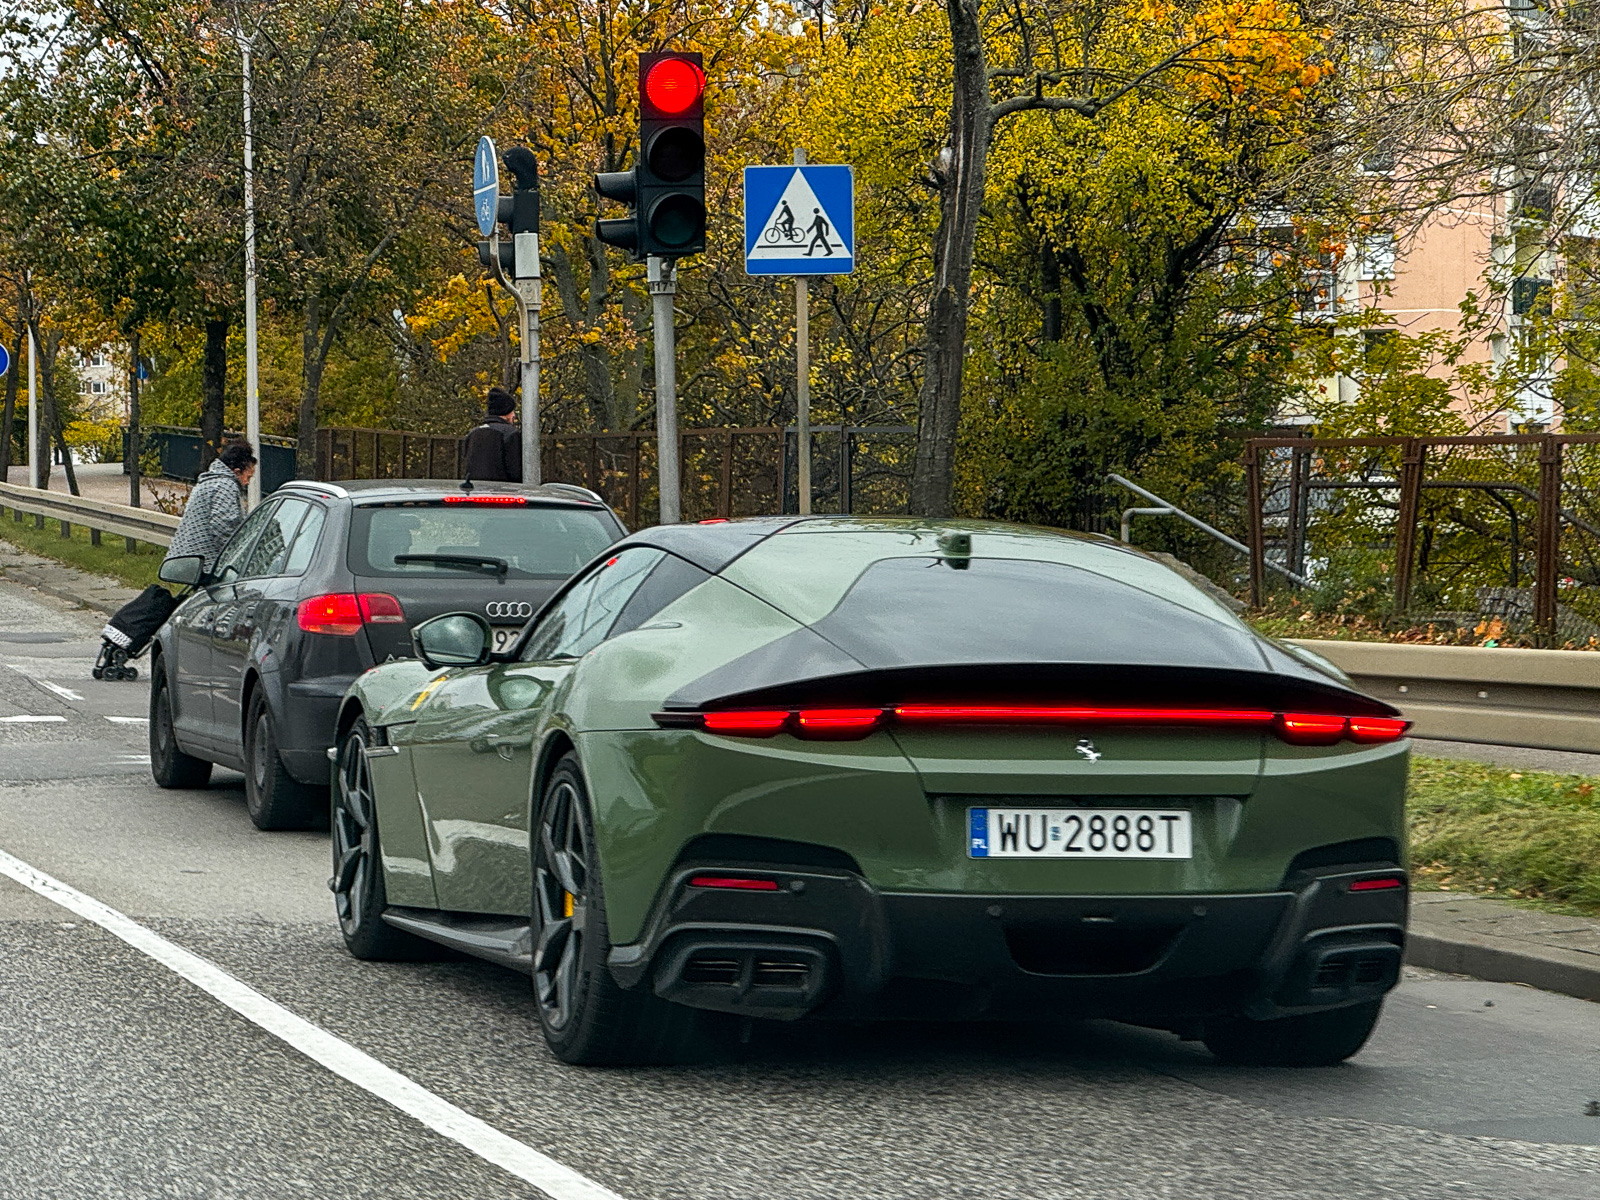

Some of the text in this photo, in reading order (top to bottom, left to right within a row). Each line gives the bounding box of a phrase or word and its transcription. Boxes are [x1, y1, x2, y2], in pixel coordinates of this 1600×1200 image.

[972, 838, 988, 849] PL
[998, 814, 1181, 853] WU 2888T
